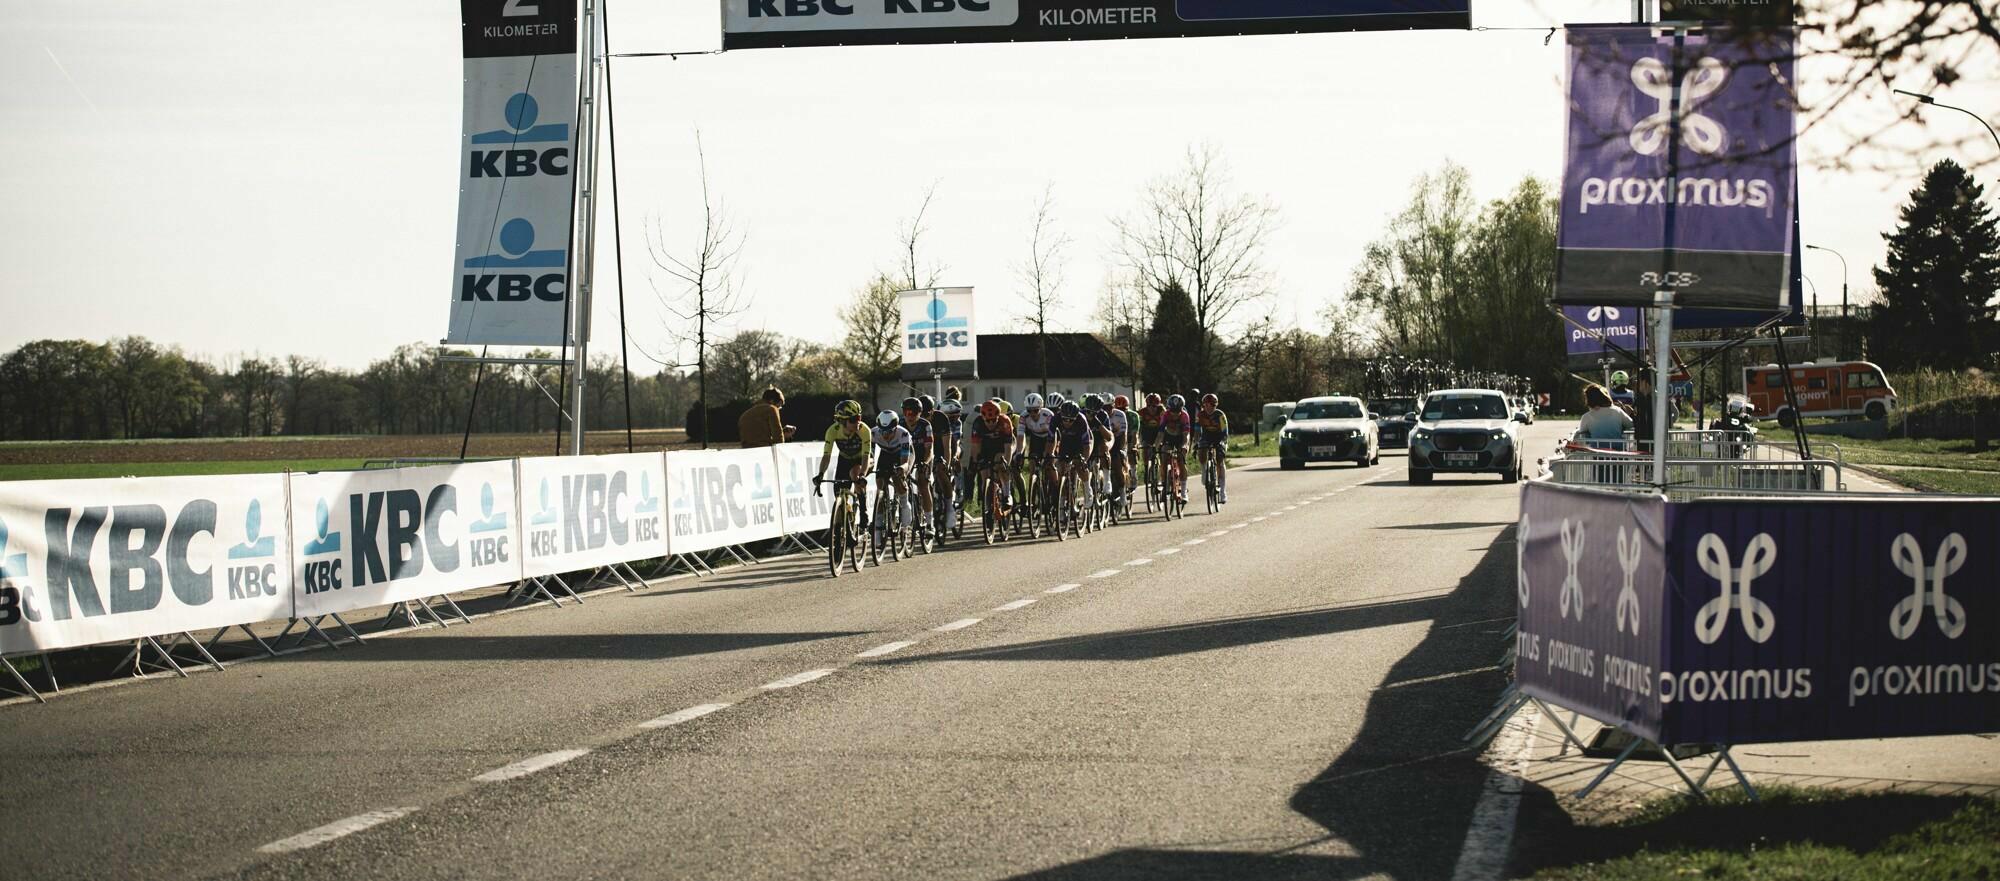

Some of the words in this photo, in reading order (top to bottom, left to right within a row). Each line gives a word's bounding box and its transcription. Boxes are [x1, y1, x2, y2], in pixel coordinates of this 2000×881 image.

[484, 23, 558, 38] KILOMETER
[1040, 7, 1156, 26] KILOMETER
[470, 147, 569, 178] KBC
[1580, 177, 1768, 214] proximus
[461, 273, 565, 302] KBC
[908, 331, 968, 350] KBC
[562, 470, 629, 554] KBC
[691, 464, 748, 534] KBC
[752, 502, 775, 526] KBC
[786, 497, 807, 518] KBC
[350, 484, 460, 587] KBC
[635, 515, 659, 543] KBC
[674, 512, 693, 537] KBC
[470, 535, 509, 568] KBC
[531, 528, 558, 557] KBC
[45, 499, 217, 621] KBC
[304, 559, 342, 594] KBC
[228, 563, 277, 600] KBC
[1547, 639, 1594, 678] proximus
[1603, 654, 1652, 697] proximus
[1849, 662, 2000, 707] proximus
